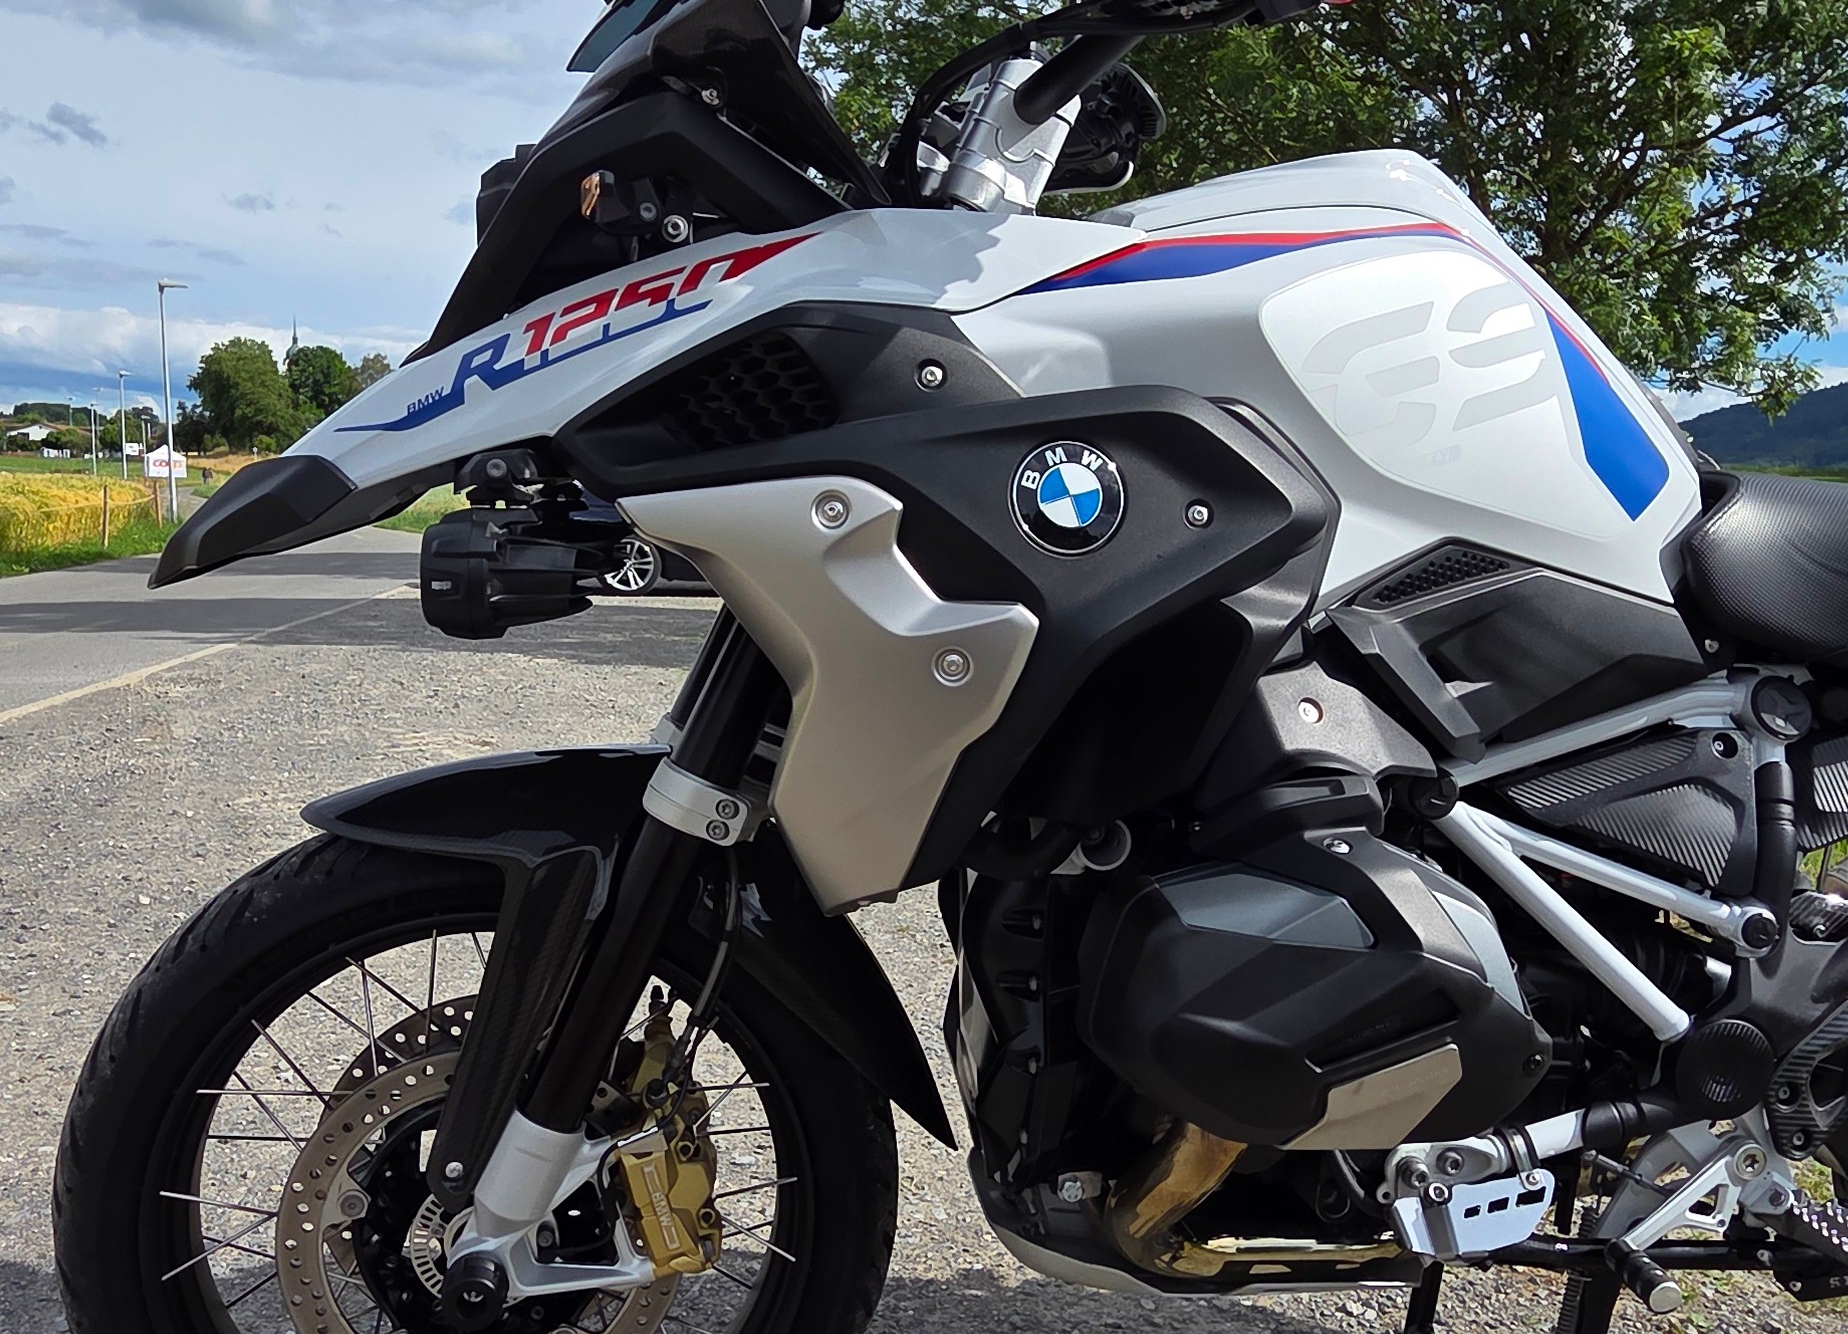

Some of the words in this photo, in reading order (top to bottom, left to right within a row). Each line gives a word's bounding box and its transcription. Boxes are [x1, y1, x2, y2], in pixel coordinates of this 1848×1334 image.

[407, 386, 445, 416] BMW
[153, 459, 183, 470] cop
[1021, 446, 1104, 490] BMW
